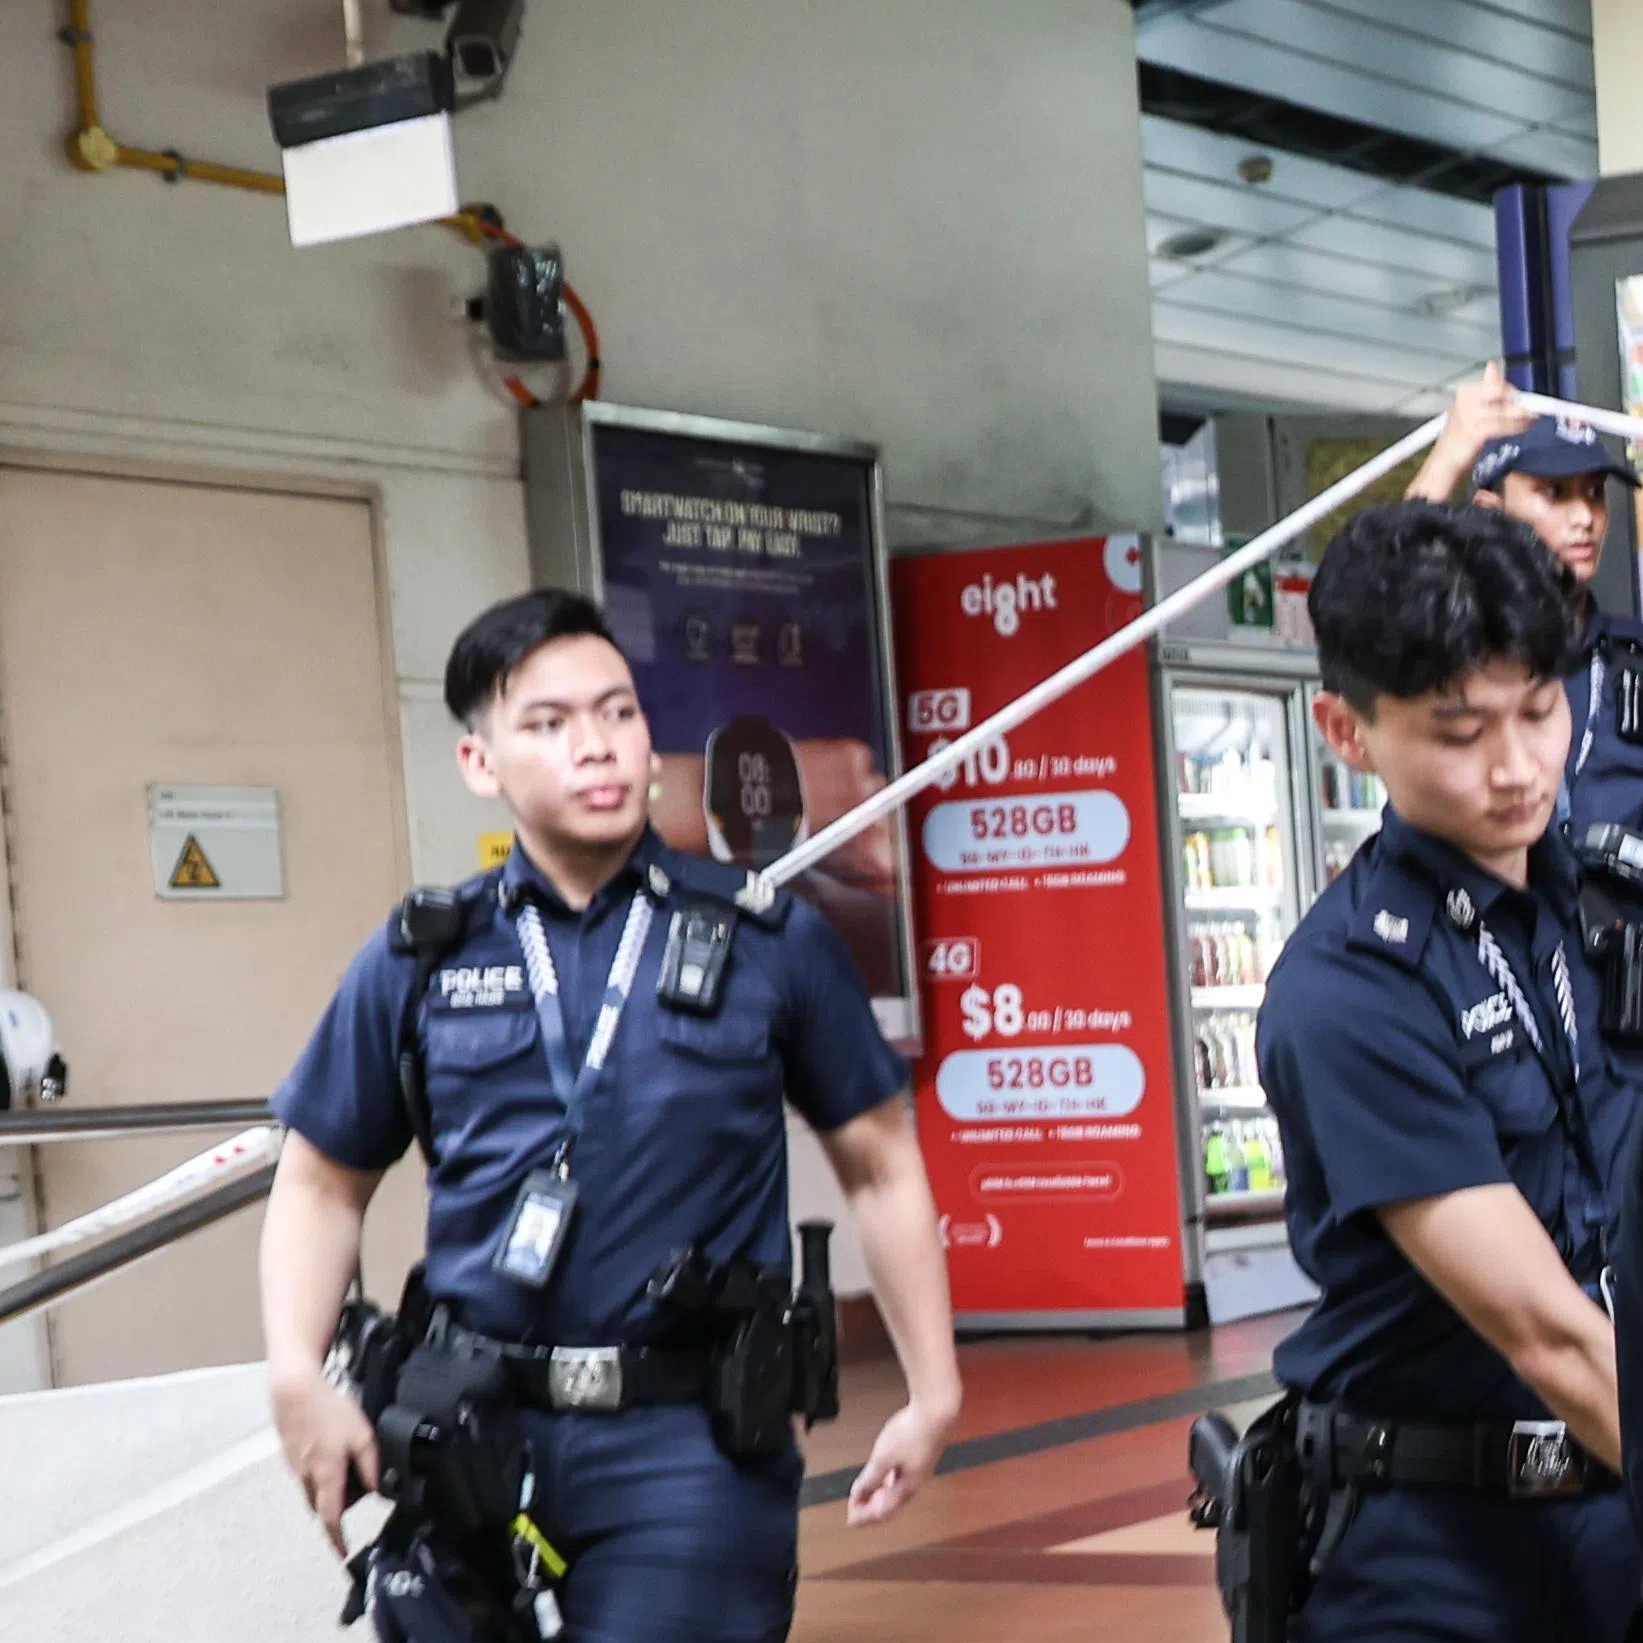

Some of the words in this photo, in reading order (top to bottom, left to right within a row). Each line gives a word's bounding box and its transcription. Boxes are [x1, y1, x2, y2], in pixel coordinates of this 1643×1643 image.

[960, 572, 1058, 637] eight
[917, 694, 959, 725] 5G
[970, 803, 1077, 841] 528GB
[928, 941, 972, 974] 4G
[440, 964, 524, 997] POLICE
[986, 1056, 1093, 1092] 528GB
